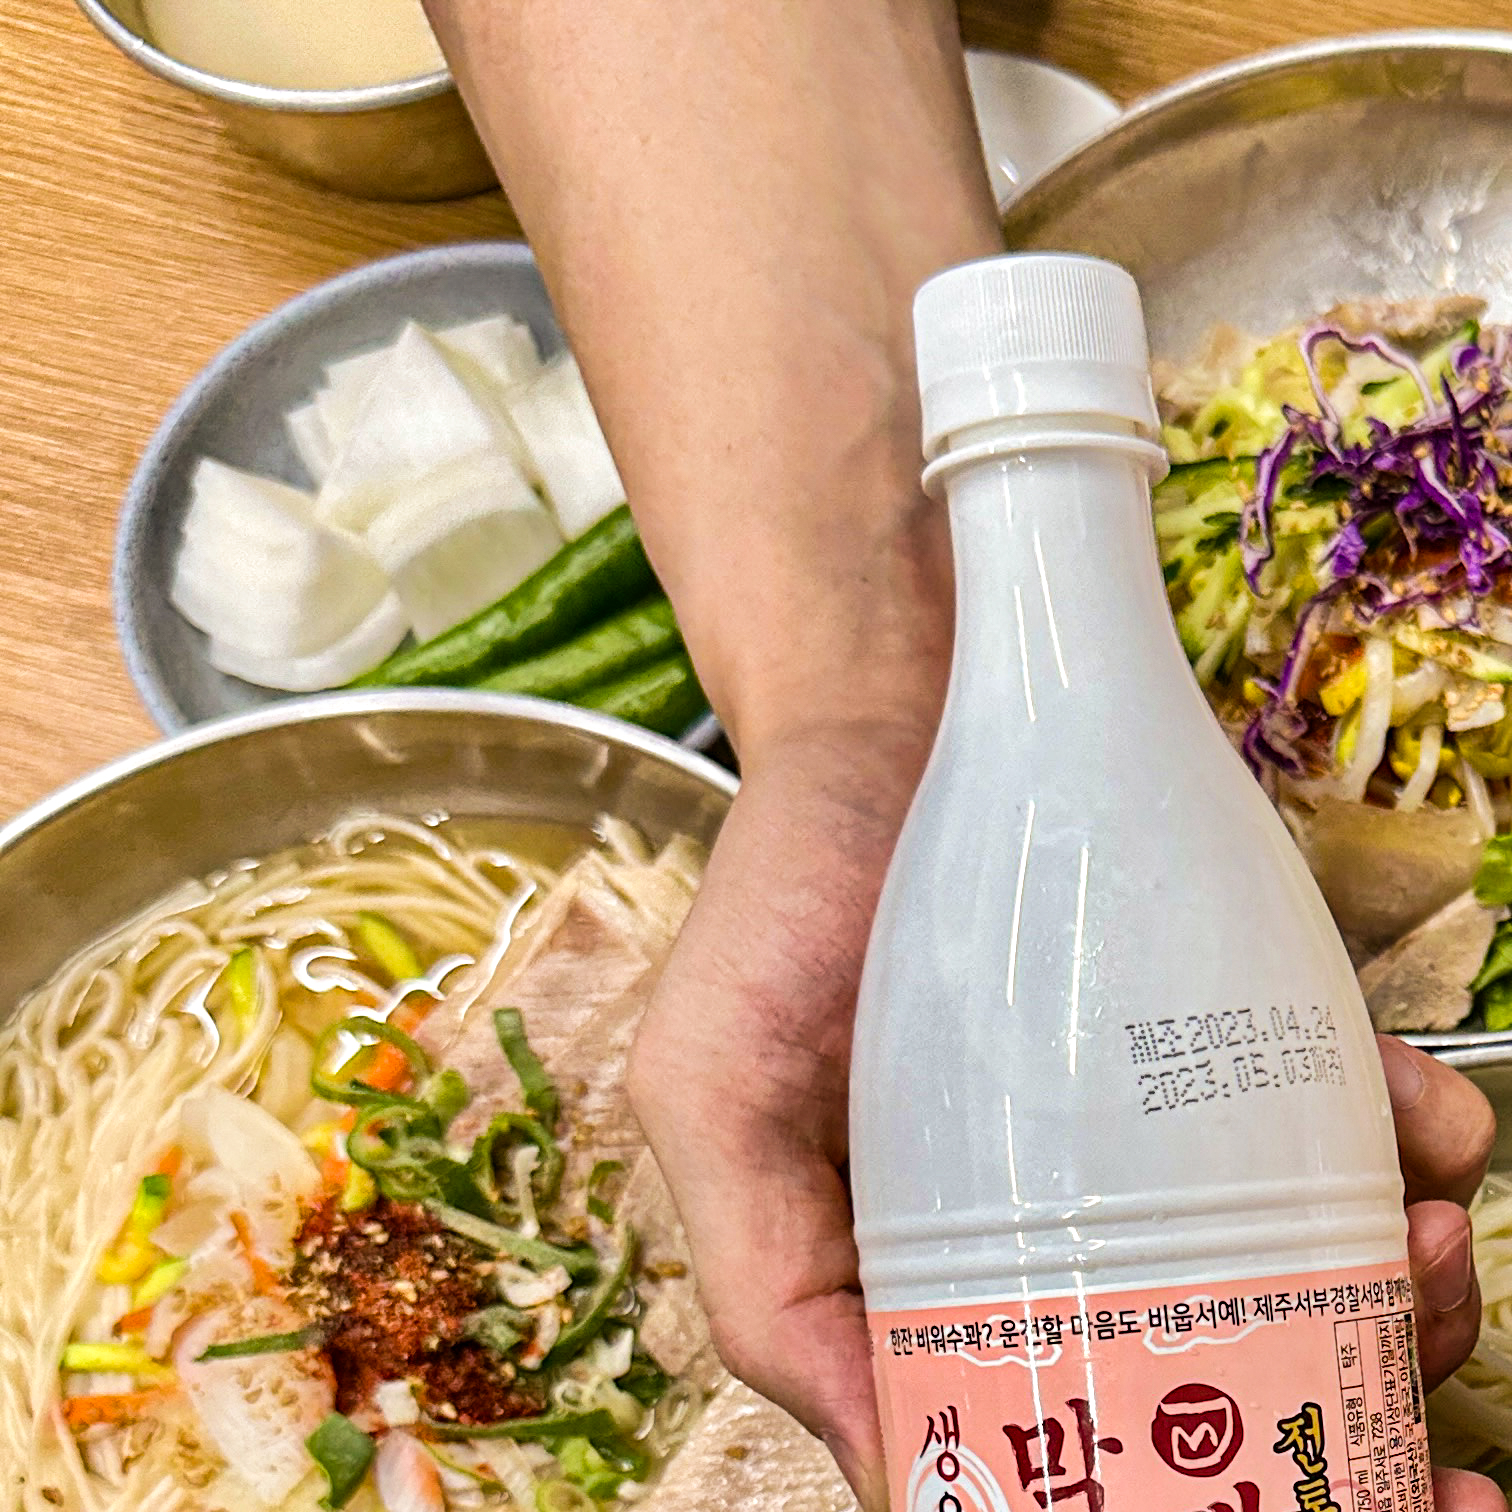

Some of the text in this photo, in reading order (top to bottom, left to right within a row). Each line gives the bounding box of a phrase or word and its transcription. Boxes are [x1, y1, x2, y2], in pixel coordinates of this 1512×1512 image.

[890, 1327, 913, 1356] 한잔
[916, 1322, 993, 1355] 비워수꽈?
[999, 1314, 1063, 1348] 운전할
[1071, 1309, 1142, 1341] 마음도
[1148, 1297, 1247, 1334] 비웁서예!
[1253, 1279, 1384, 1325] 제주서부경찰서와
[1339, 1342, 1358, 1368] 탁주
[1344, 1395, 1366, 1447] 식품유형
[1368, 1411, 1384, 1440] 7238
[1353, 1468, 1369, 1484] ml
[1371, 1444, 1391, 1494] 일주서로
